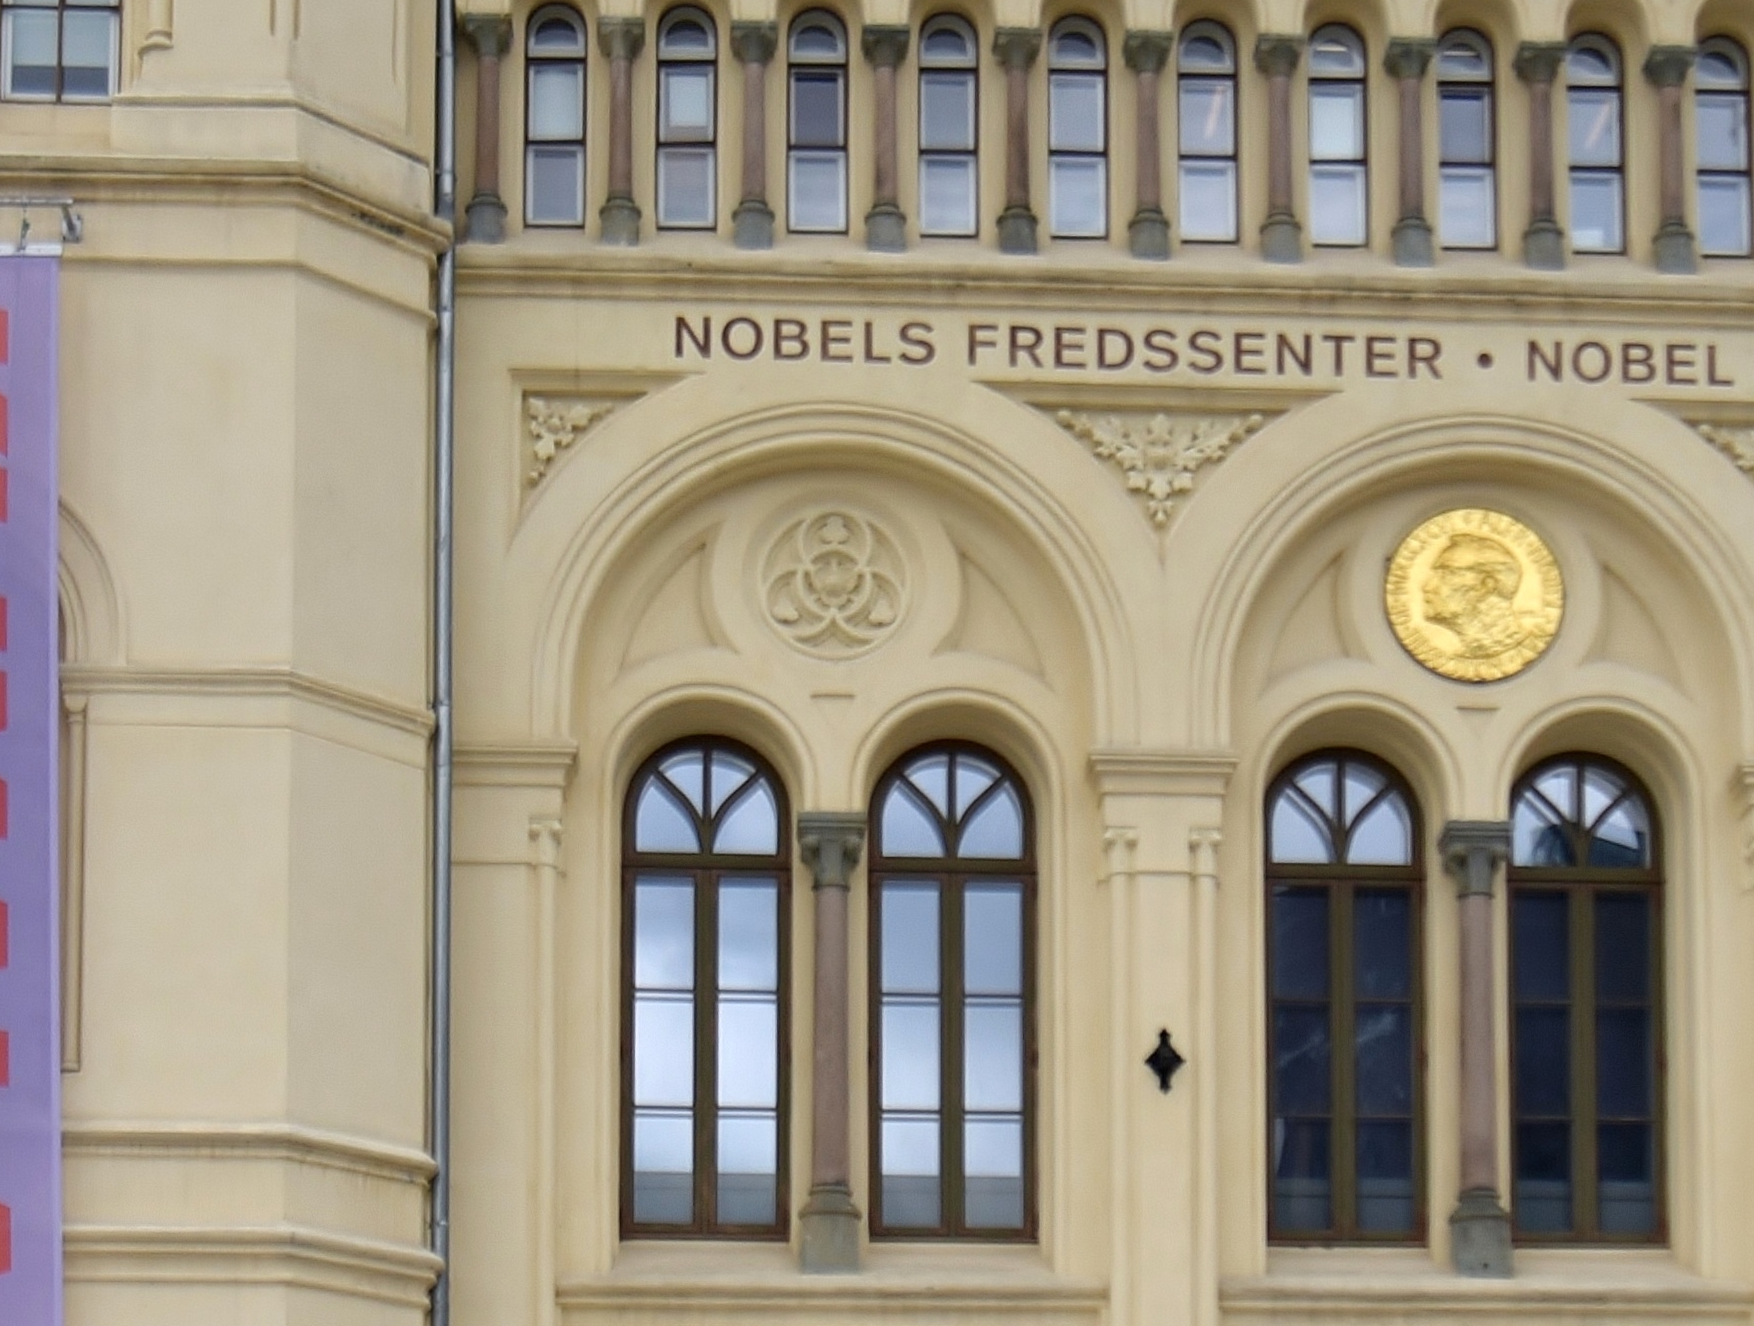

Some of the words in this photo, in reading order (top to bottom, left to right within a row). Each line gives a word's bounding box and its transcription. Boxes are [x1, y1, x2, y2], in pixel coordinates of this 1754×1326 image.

[673, 315, 937, 366] NOBELS
[966, 323, 1442, 379] FREDSSENTER
[1526, 338, 1734, 387] NOBEL
